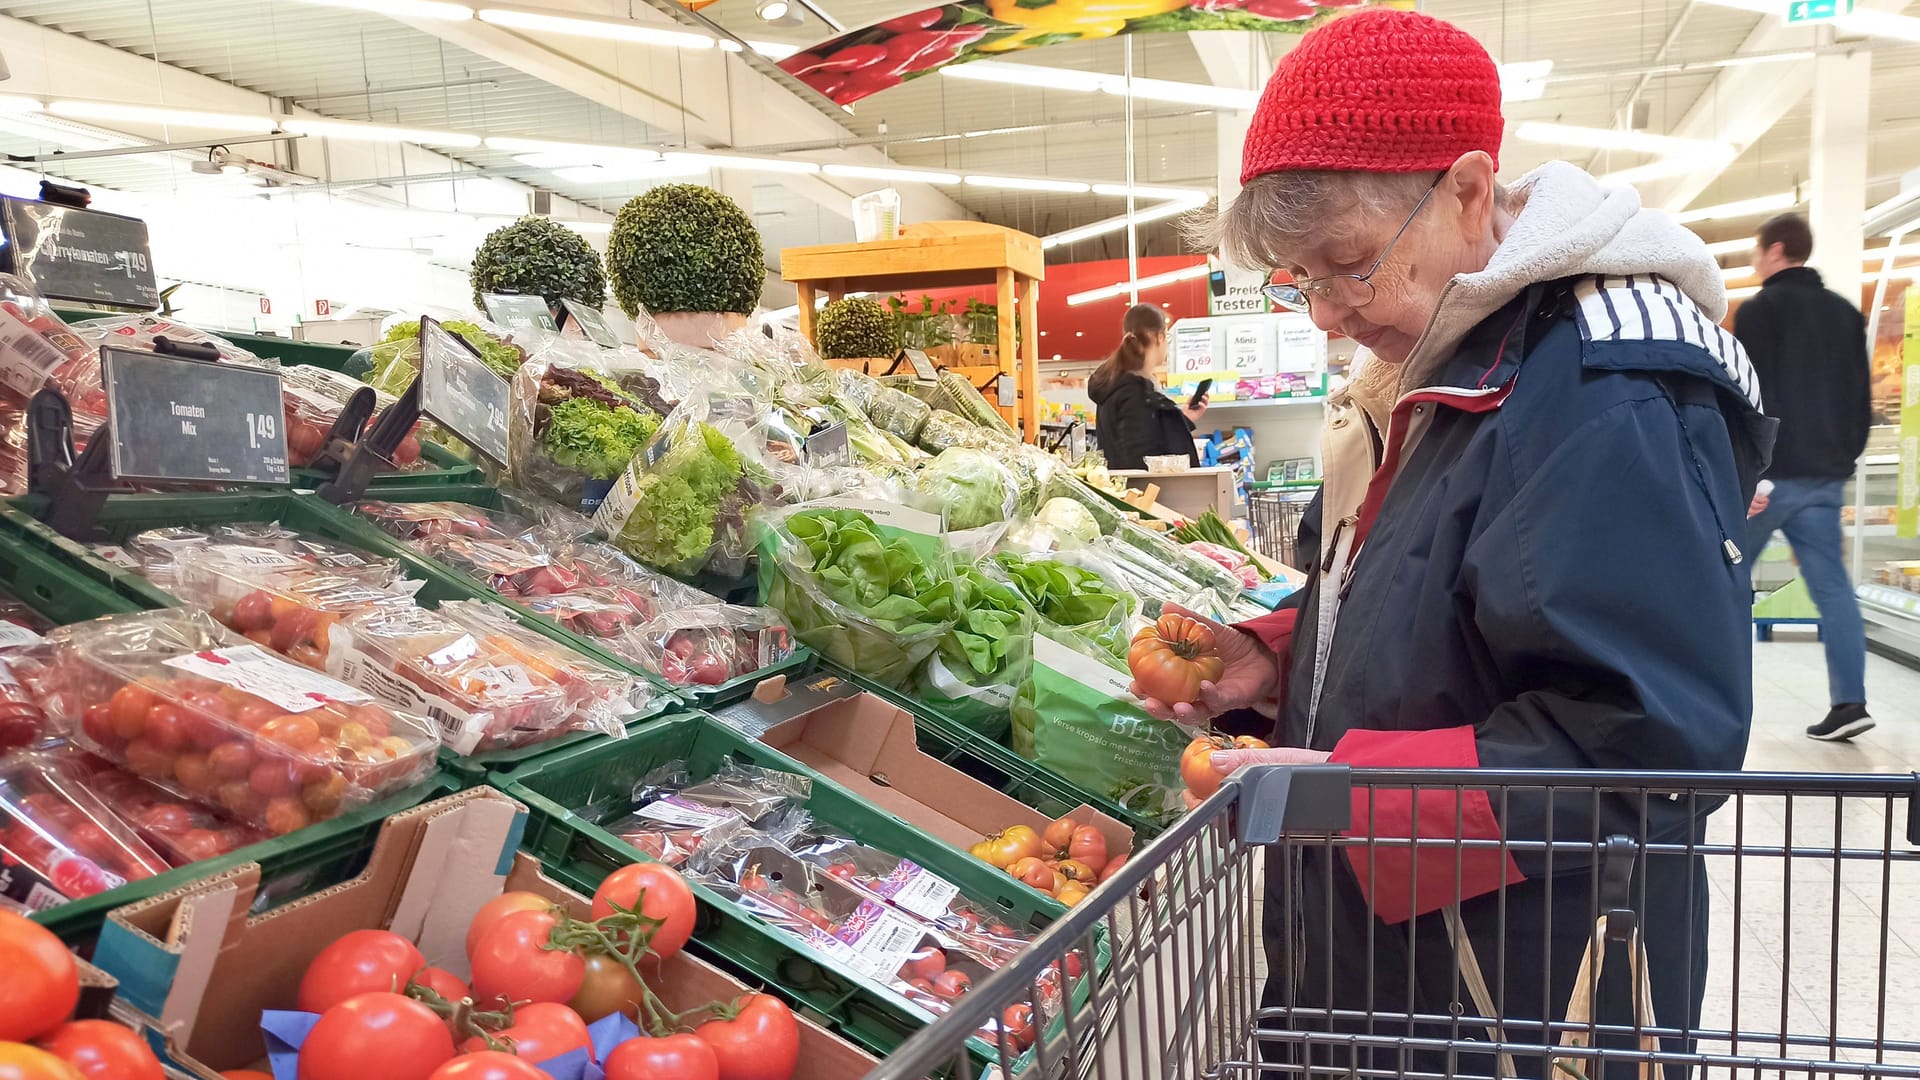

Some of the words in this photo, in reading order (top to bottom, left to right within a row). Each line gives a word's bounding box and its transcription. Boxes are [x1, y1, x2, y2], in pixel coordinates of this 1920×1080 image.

[1229, 285, 1258, 296] Preis
[1215, 299, 1261, 310] Tester
[1235, 336, 1257, 344] Minis
[170, 401, 205, 419] Tomaten
[181, 420, 197, 436] Mix
[246, 412, 275, 449] 1.49
[984, 688, 998, 697] nder
[1053, 716, 1076, 733] Verse
[1076, 727, 1108, 748] kropsla
[1109, 740, 1127, 752] met
[1113, 754, 1147, 770] Frischer
